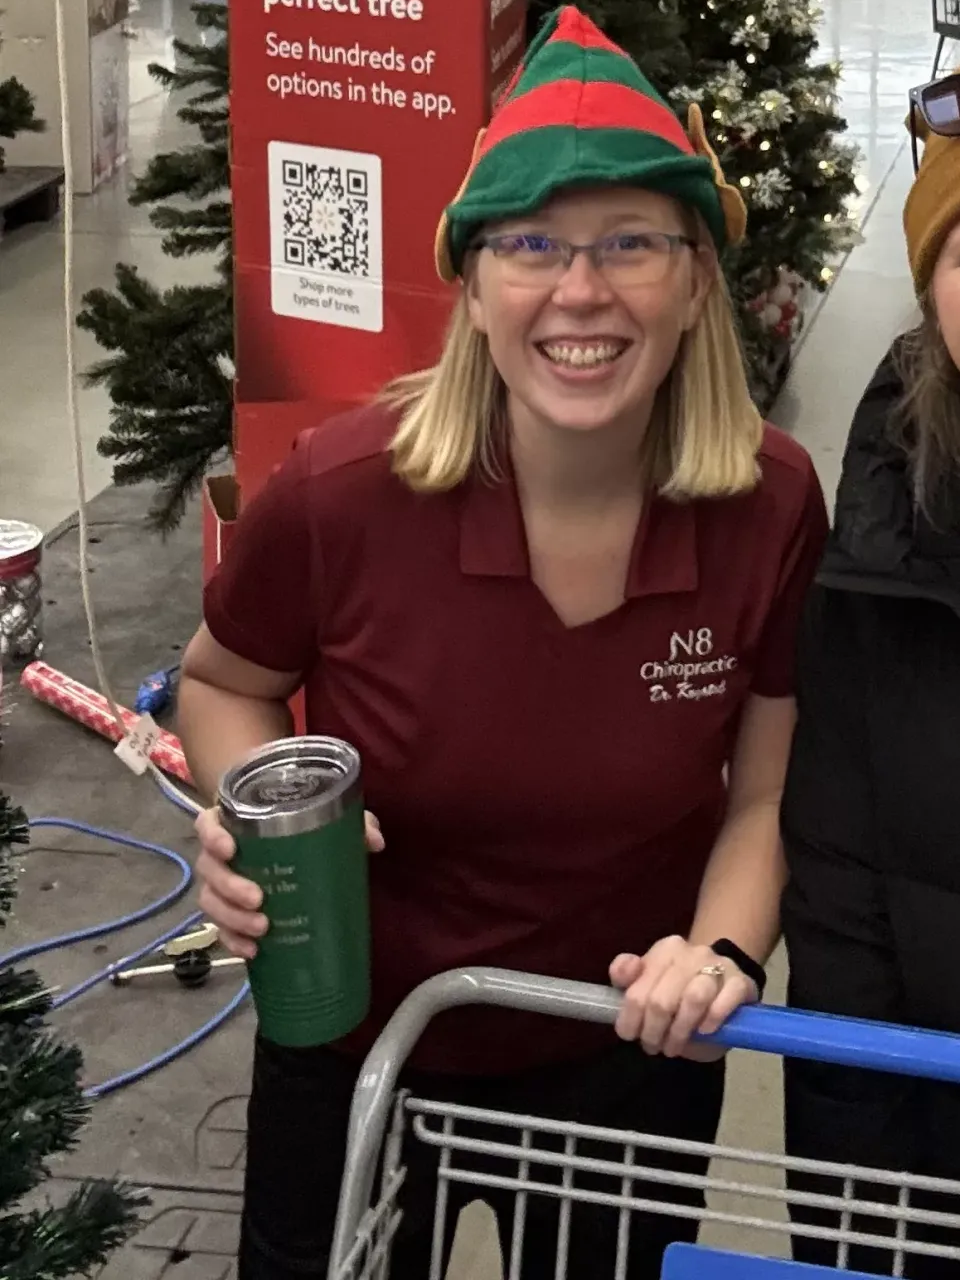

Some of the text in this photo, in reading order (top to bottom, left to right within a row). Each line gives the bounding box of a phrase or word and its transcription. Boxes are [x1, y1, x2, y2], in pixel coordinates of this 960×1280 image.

[265, 32, 436, 75] See hundreds of
[267, 71, 456, 120] options in the app.
[299, 276, 354, 298] Shop more
[293, 292, 360, 314] types of trees
[668, 627, 713, 661] N8
[640, 654, 738, 681] Chiropractic
